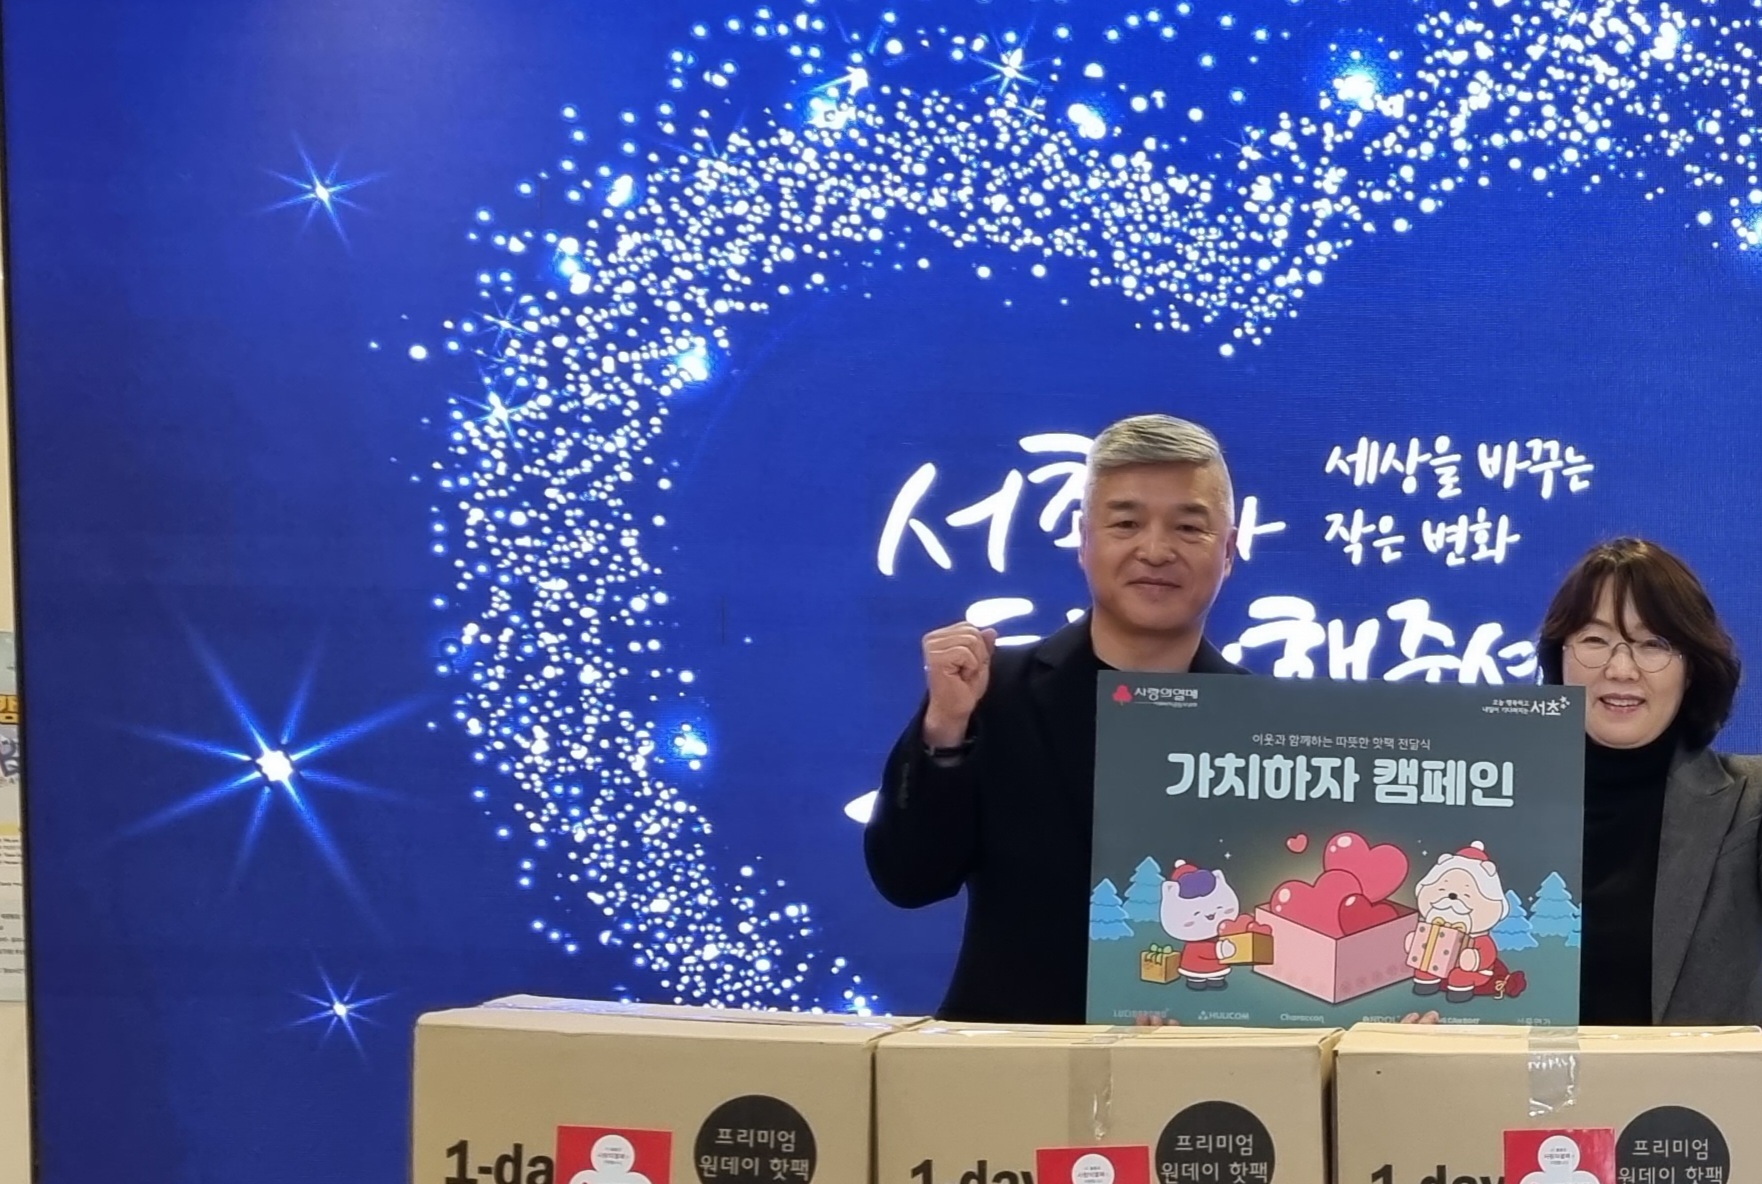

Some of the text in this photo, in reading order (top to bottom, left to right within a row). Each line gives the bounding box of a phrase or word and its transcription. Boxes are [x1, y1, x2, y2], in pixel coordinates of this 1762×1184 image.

[1324, 436, 1596, 500] 세상을 바꾸는
[1323, 507, 1521, 567] 작은 변화
[1134, 687, 1198, 701] 사랑의열매
[1530, 700, 1561, 716] 서초
[1252, 733, 1286, 746] 이웃과
[1289, 734, 1333, 747] 함께하는
[1336, 736, 1369, 749] 따뜻한
[1398, 738, 1431, 751] 전달식
[1165, 752, 1515, 807] 가치하자 캠페인
[715, 1128, 796, 1152] 프리미엄
[1175, 1134, 1253, 1156] 프리미엄
[1632, 1139, 1709, 1160] 프리미엄
[700, 1155, 809, 1183] 원데이 핫팩
[1161, 1162, 1268, 1184] 원데이 핫팩
